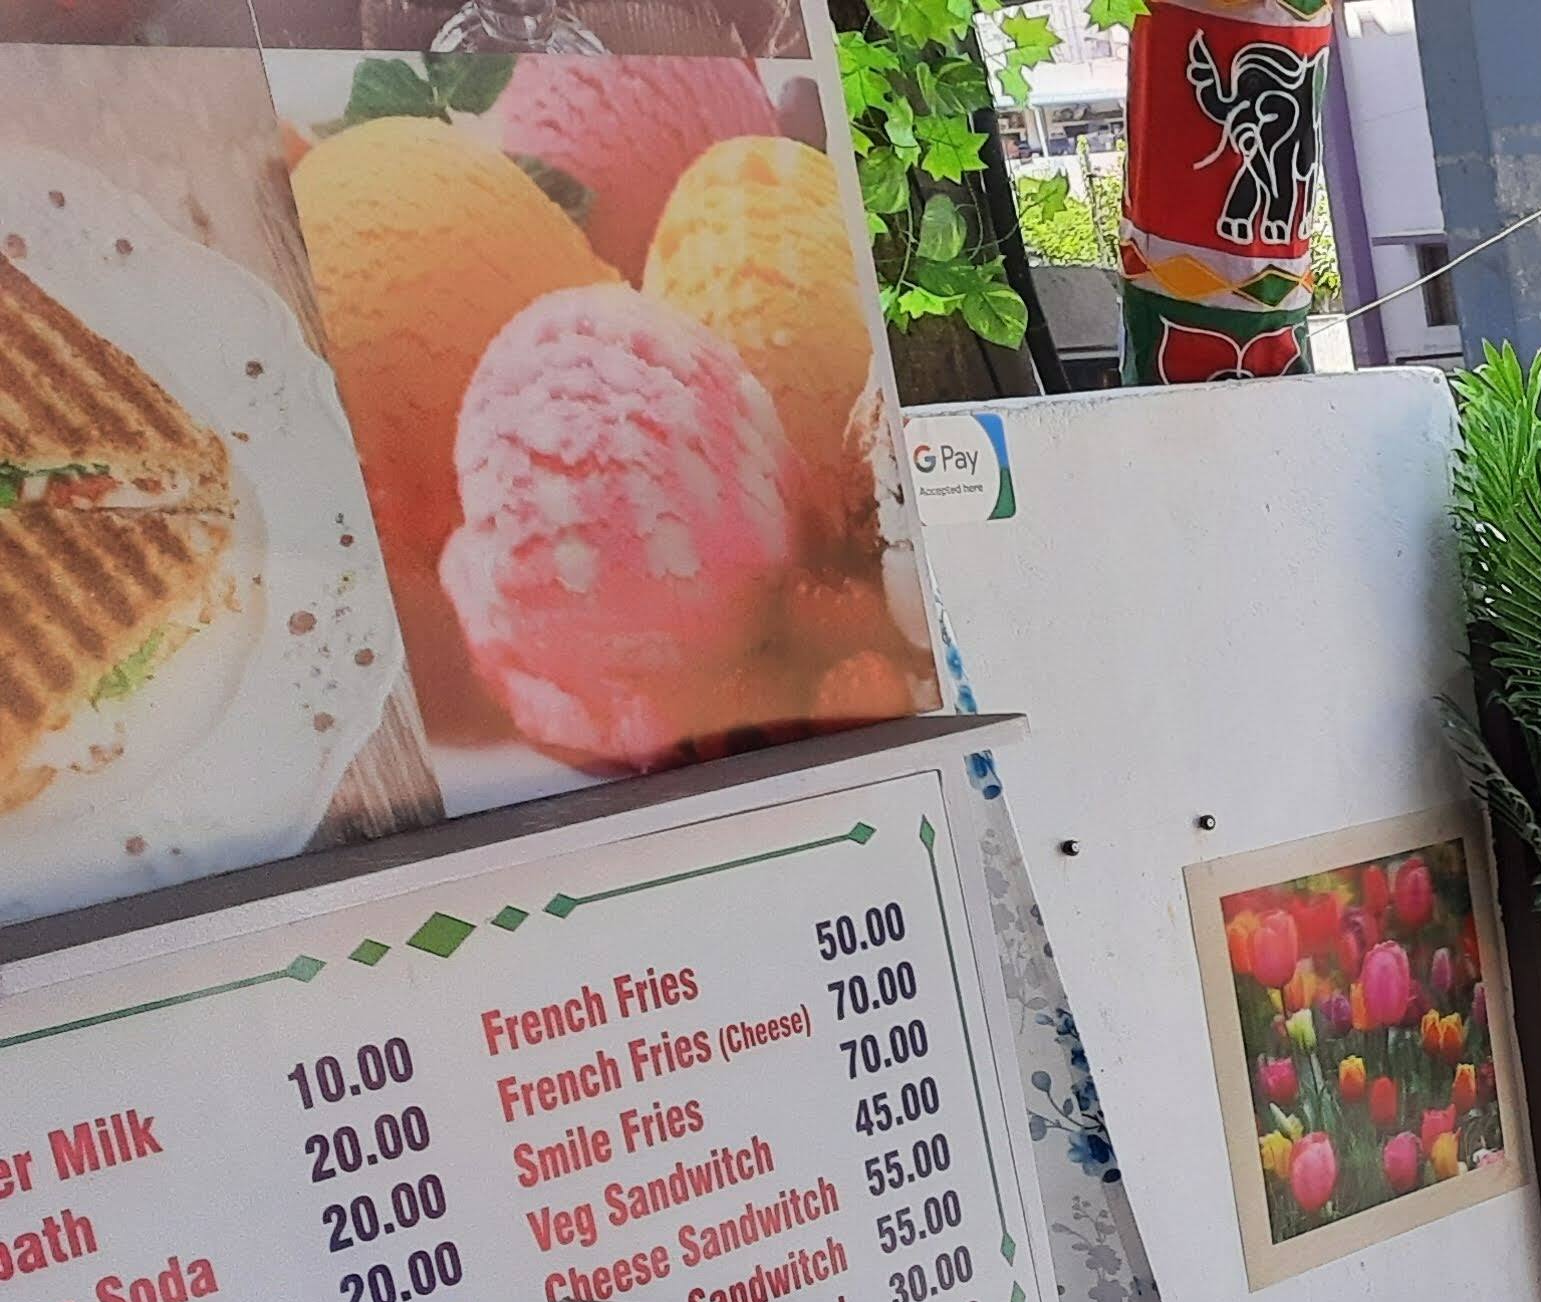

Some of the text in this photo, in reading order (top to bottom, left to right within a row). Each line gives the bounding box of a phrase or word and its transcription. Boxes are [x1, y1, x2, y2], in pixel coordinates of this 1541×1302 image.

[913, 444, 978, 475] G Pay
[481, 902, 906, 1056] French Fries 50.00
[497, 961, 918, 1122] French Fries (Cheese) 70.00
[48, 1109, 163, 1181] Milk
[288, 1037, 414, 1109] 10.00
[305, 1106, 430, 1182] 20.00
[513, 1019, 929, 1189] Smile Fries 70.00
[526, 1076, 941, 1253] Veg Sandwitch 45.00
[322, 1174, 447, 1252] 20.00
[678, 1176, 840, 1267] Sandwitch
[865, 1132, 952, 1196] 55.00
[877, 1190, 962, 1255] 55.00
